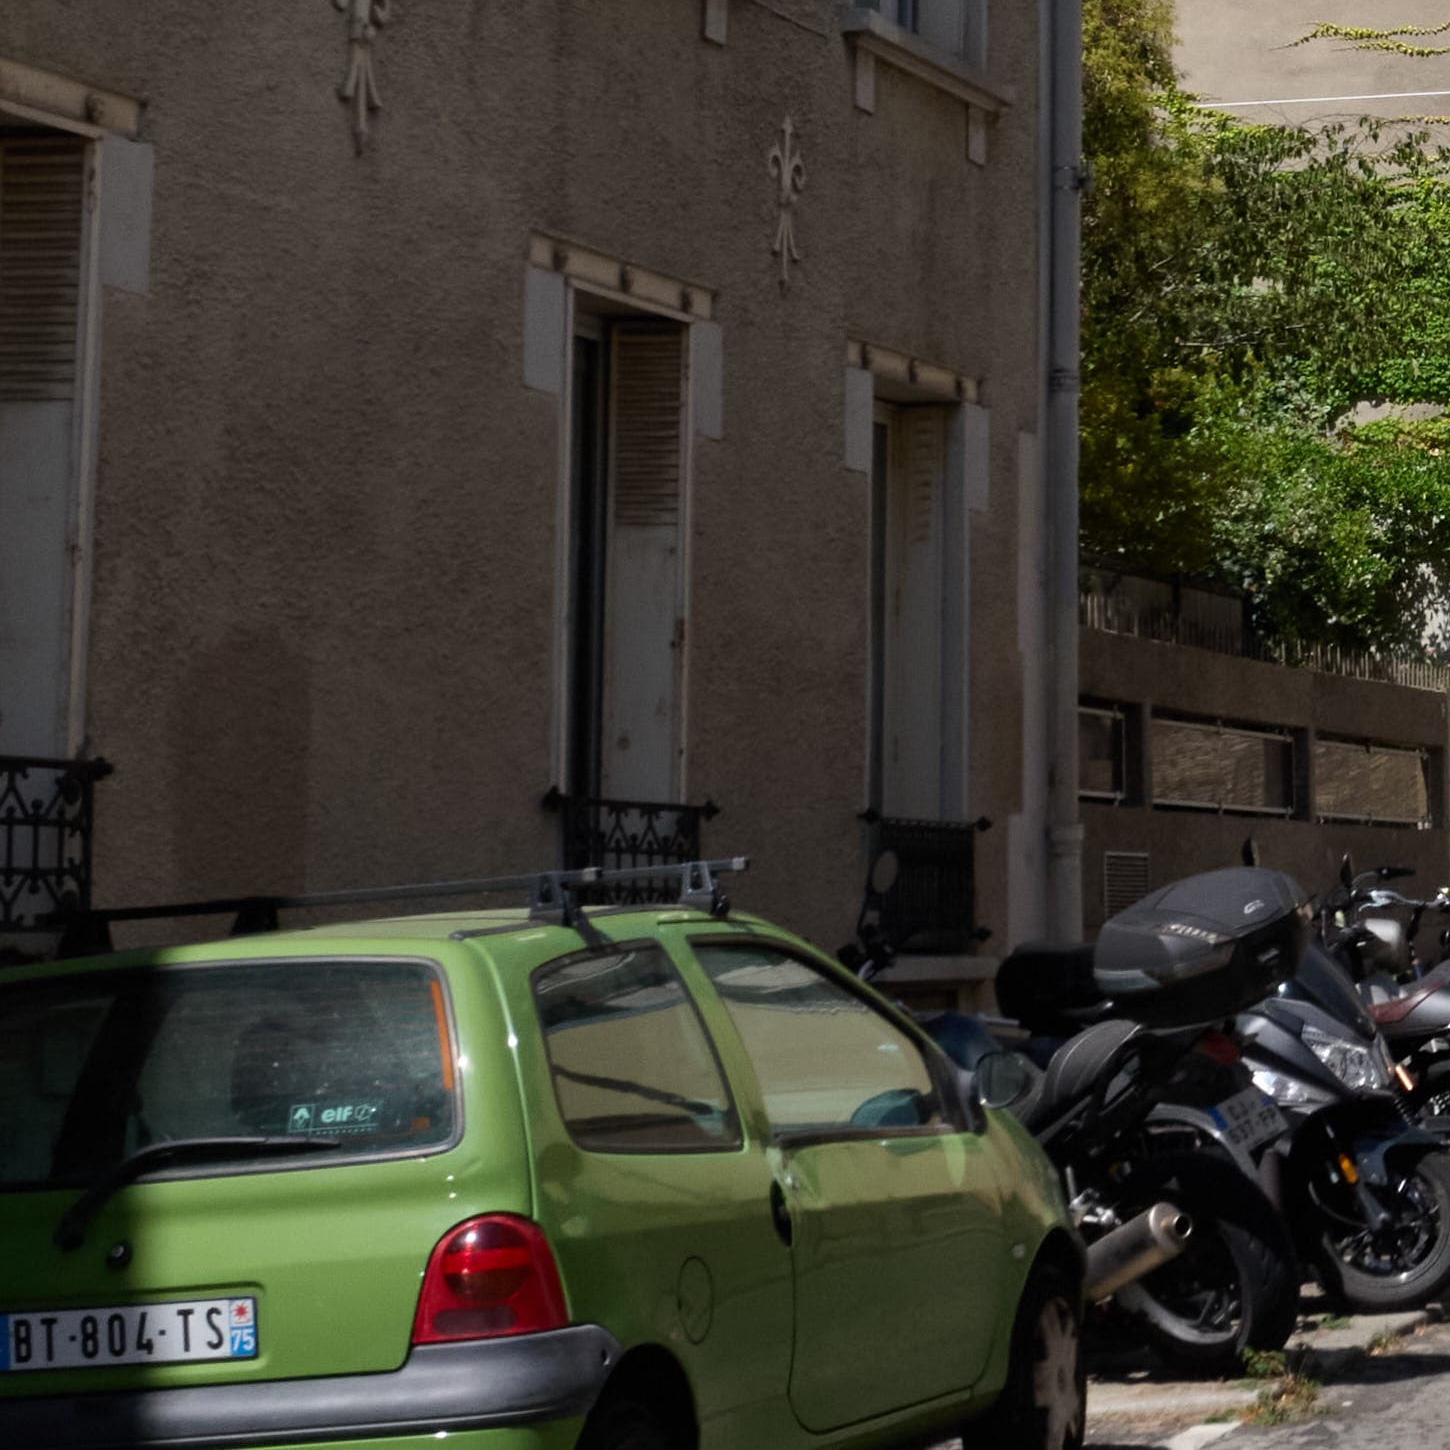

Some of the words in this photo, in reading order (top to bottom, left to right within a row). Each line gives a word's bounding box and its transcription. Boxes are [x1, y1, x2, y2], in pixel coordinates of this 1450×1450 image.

[321, 1106, 353, 1123] elf
[13, 1307, 224, 1364] BT-804-TS
[231, 1329, 255, 1352] 75
